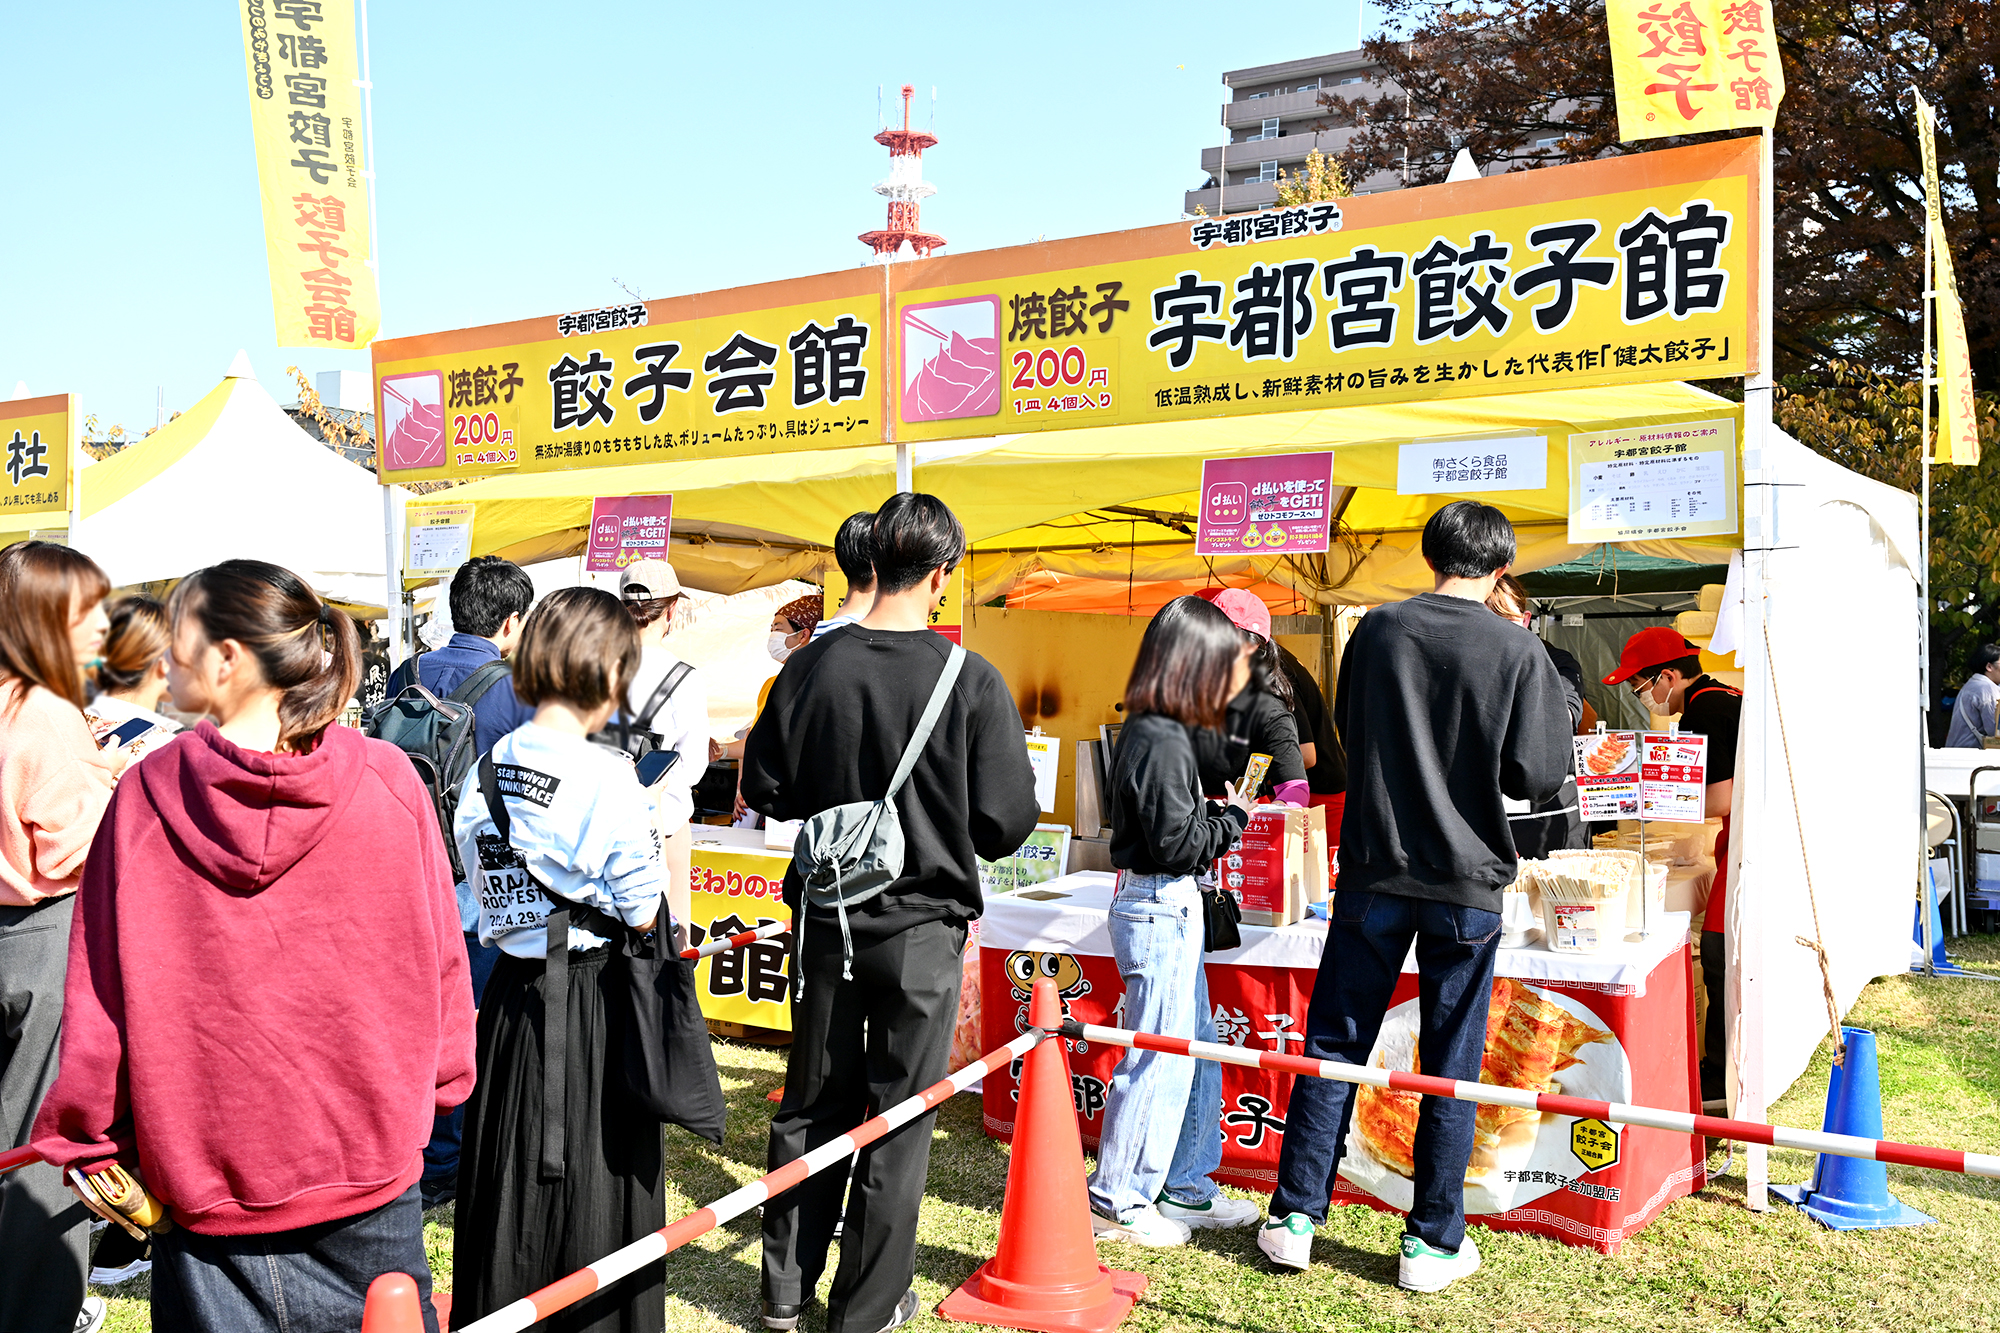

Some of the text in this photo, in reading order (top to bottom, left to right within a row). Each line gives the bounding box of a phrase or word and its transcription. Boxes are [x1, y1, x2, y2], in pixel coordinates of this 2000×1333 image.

[1193, 203, 1340, 247] 宇都宮餃子
[1149, 204, 1729, 368] 宇都宮餃子館
[559, 306, 647, 336] 宇都宮餃子
[1008, 281, 1130, 342] 焼餃子
[549, 317, 869, 430] 餃子会館
[1011, 345, 1108, 391] 200円
[1154, 336, 1730, 408] 低温熟成し、新鮮素材の旨みを生かした代表作「健太餃子」
[448, 362, 524, 408] 焼餃子
[1014, 394, 1112, 414] 1皿 4個入り
[453, 412, 514, 447] 200円
[534, 416, 870, 460] 無添加湯練りのもちもちした皮、ボリュームたっぷり、具はジューシー
[1589, 428, 1719, 447] アレルギー・原材料情報のご案内
[7, 431, 49, 485] 杜
[456, 449, 518, 465] 1皿 4個入り
[1614, 442, 1688, 459] 宇都宮餃子館
[1251, 480, 1325, 496] d払いを使って
[1432, 466, 1508, 483] 宇都宮餃子館
[1211, 492, 1242, 506] d払い
[597, 523, 618, 534] d払い
[1576, 1134, 1613, 1151] 餃子会
[1580, 1126, 1606, 1138] 宇都宮
[1504, 1170, 1620, 1202] 宇都宮餃子会加盟店
